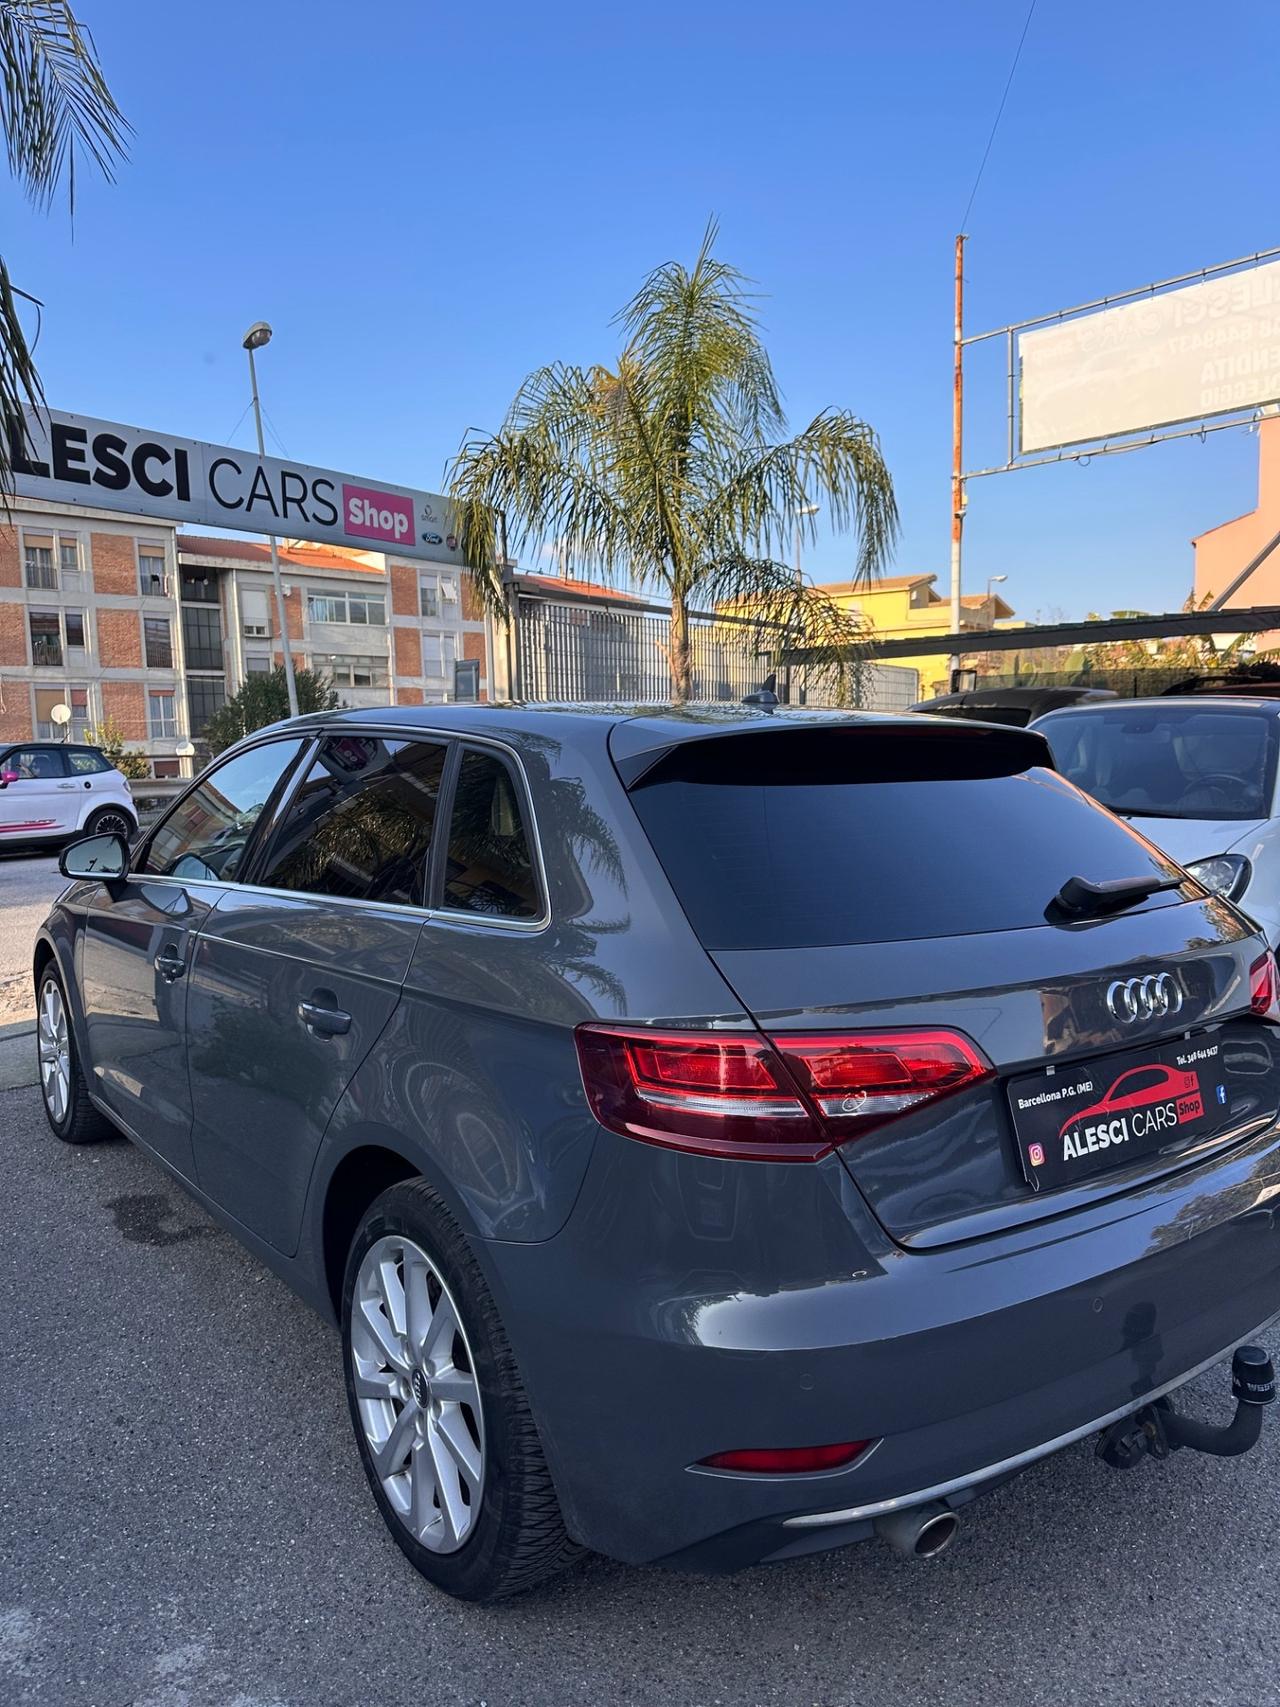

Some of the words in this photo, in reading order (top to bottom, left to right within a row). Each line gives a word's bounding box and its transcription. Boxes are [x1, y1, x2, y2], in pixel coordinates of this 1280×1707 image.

[208, 457, 339, 527] CARS
[349, 497, 409, 538] Shop
[1018, 1090, 1062, 1109] Barcellona
[1061, 1086, 1076, 1099] P.G.
[1077, 1081, 1093, 1094] (ME)
[1063, 1118, 1130, 1161] ALESCI
[1132, 1103, 1177, 1137] CARS
[1179, 1099, 1200, 1116] Shop
